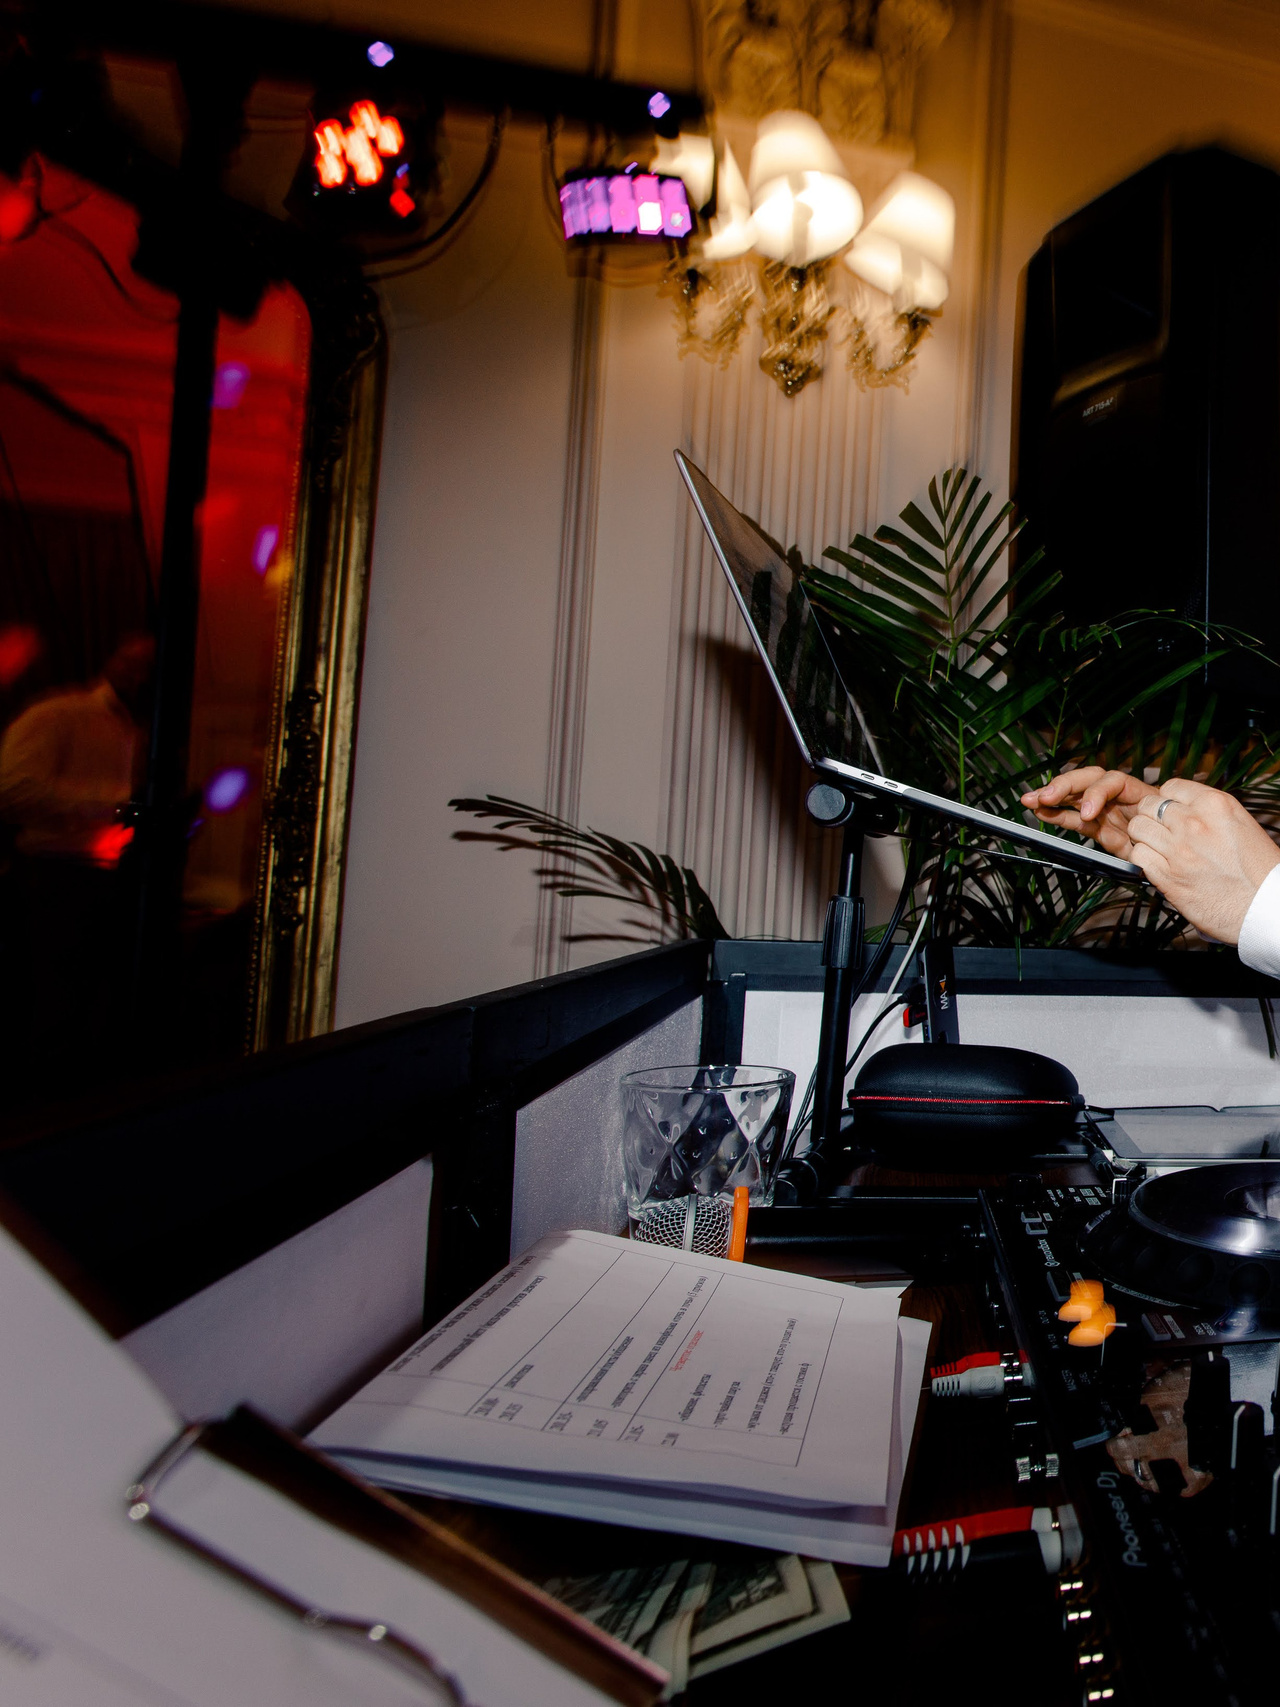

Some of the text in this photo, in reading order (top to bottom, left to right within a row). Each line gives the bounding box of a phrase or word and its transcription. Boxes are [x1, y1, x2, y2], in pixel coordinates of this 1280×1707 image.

[1082, 406, 1094, 418] ART
[1037, 1238, 1055, 1262] rekordbox
[1107, 1492, 1148, 1568] Pioneer
